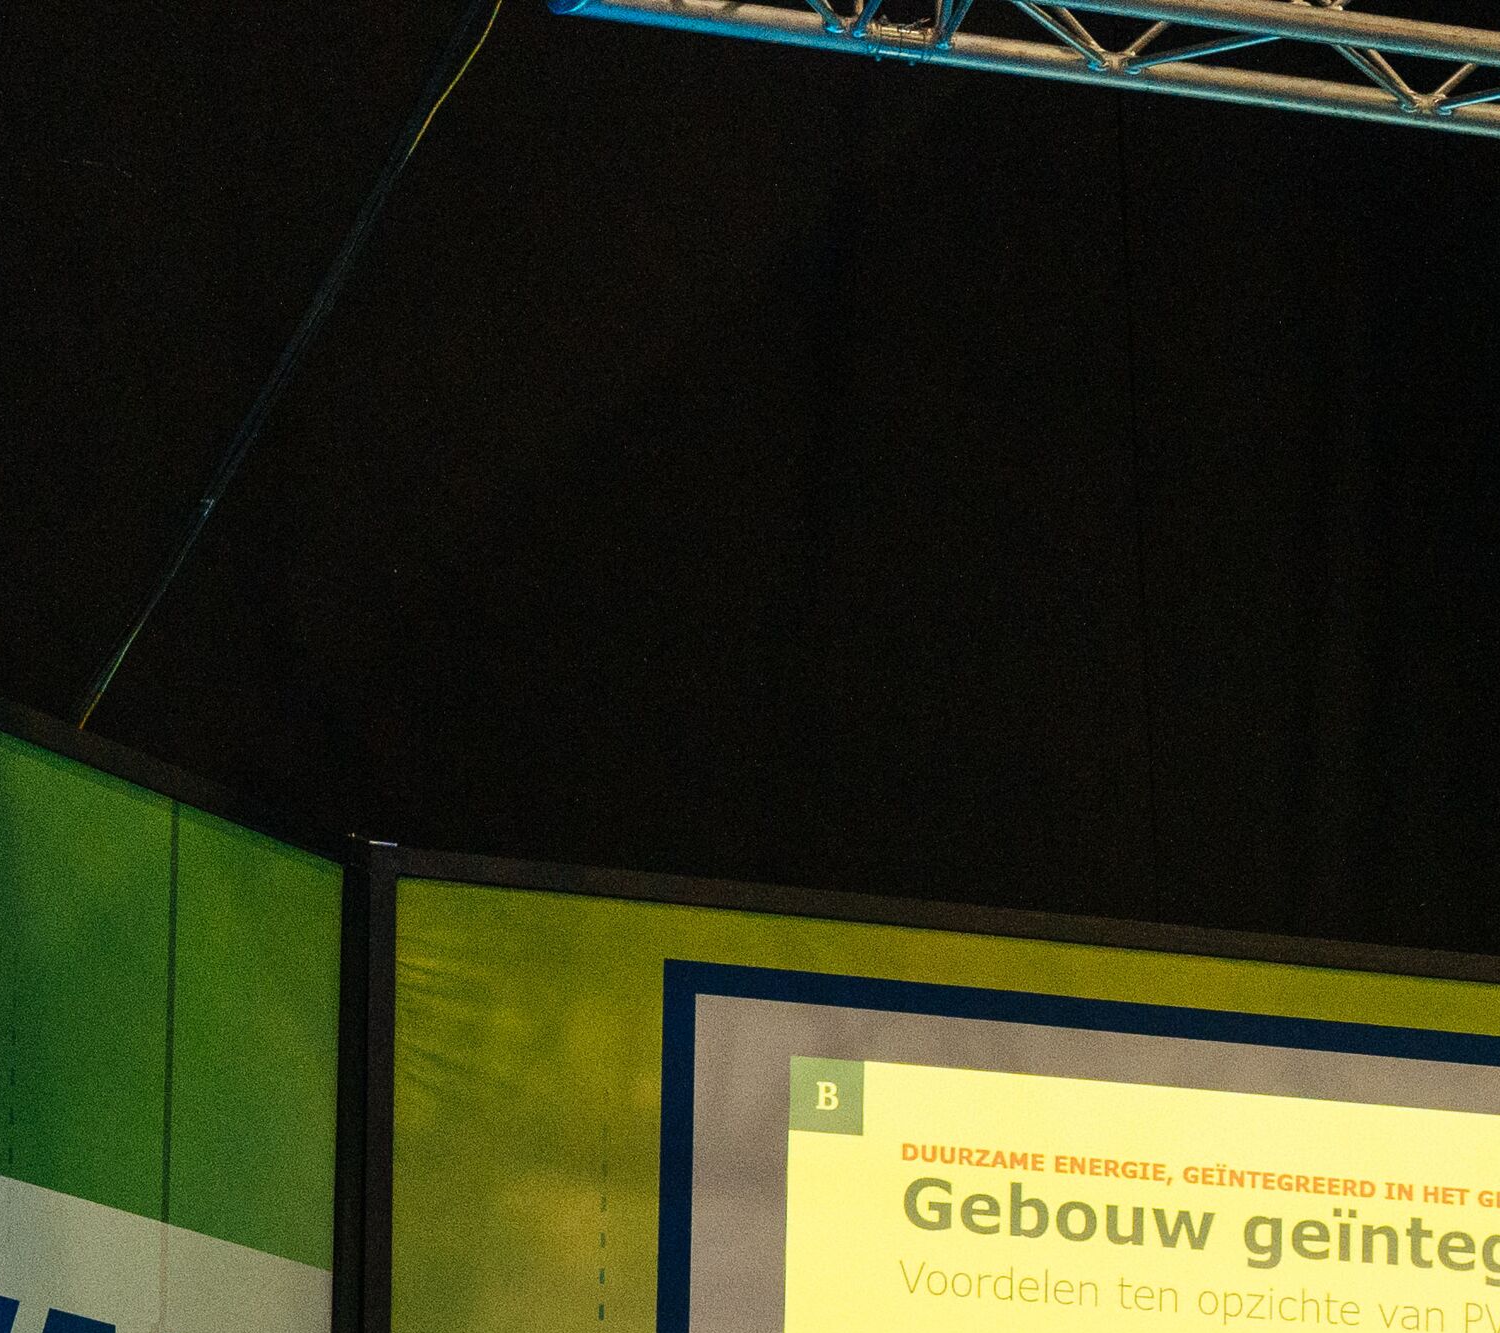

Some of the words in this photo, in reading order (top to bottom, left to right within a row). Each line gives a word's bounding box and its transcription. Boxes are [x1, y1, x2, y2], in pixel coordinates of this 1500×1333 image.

[815, 1081, 839, 1111] B
[901, 1142, 1046, 1173] DUURZAME
[1053, 1155, 1174, 1187] ENERGIE,
[1182, 1162, 1377, 1198] GEÏNTEGREERD
[1384, 1182, 1415, 1202] IN
[1423, 1185, 1471, 1206] HET
[902, 1176, 1216, 1251] Gebouw
[899, 1260, 1099, 1307] Voordelen
[1117, 1276, 1178, 1313] ten
[1198, 1287, 1360, 1326] opzichte
[1378, 1304, 1445, 1332] van
